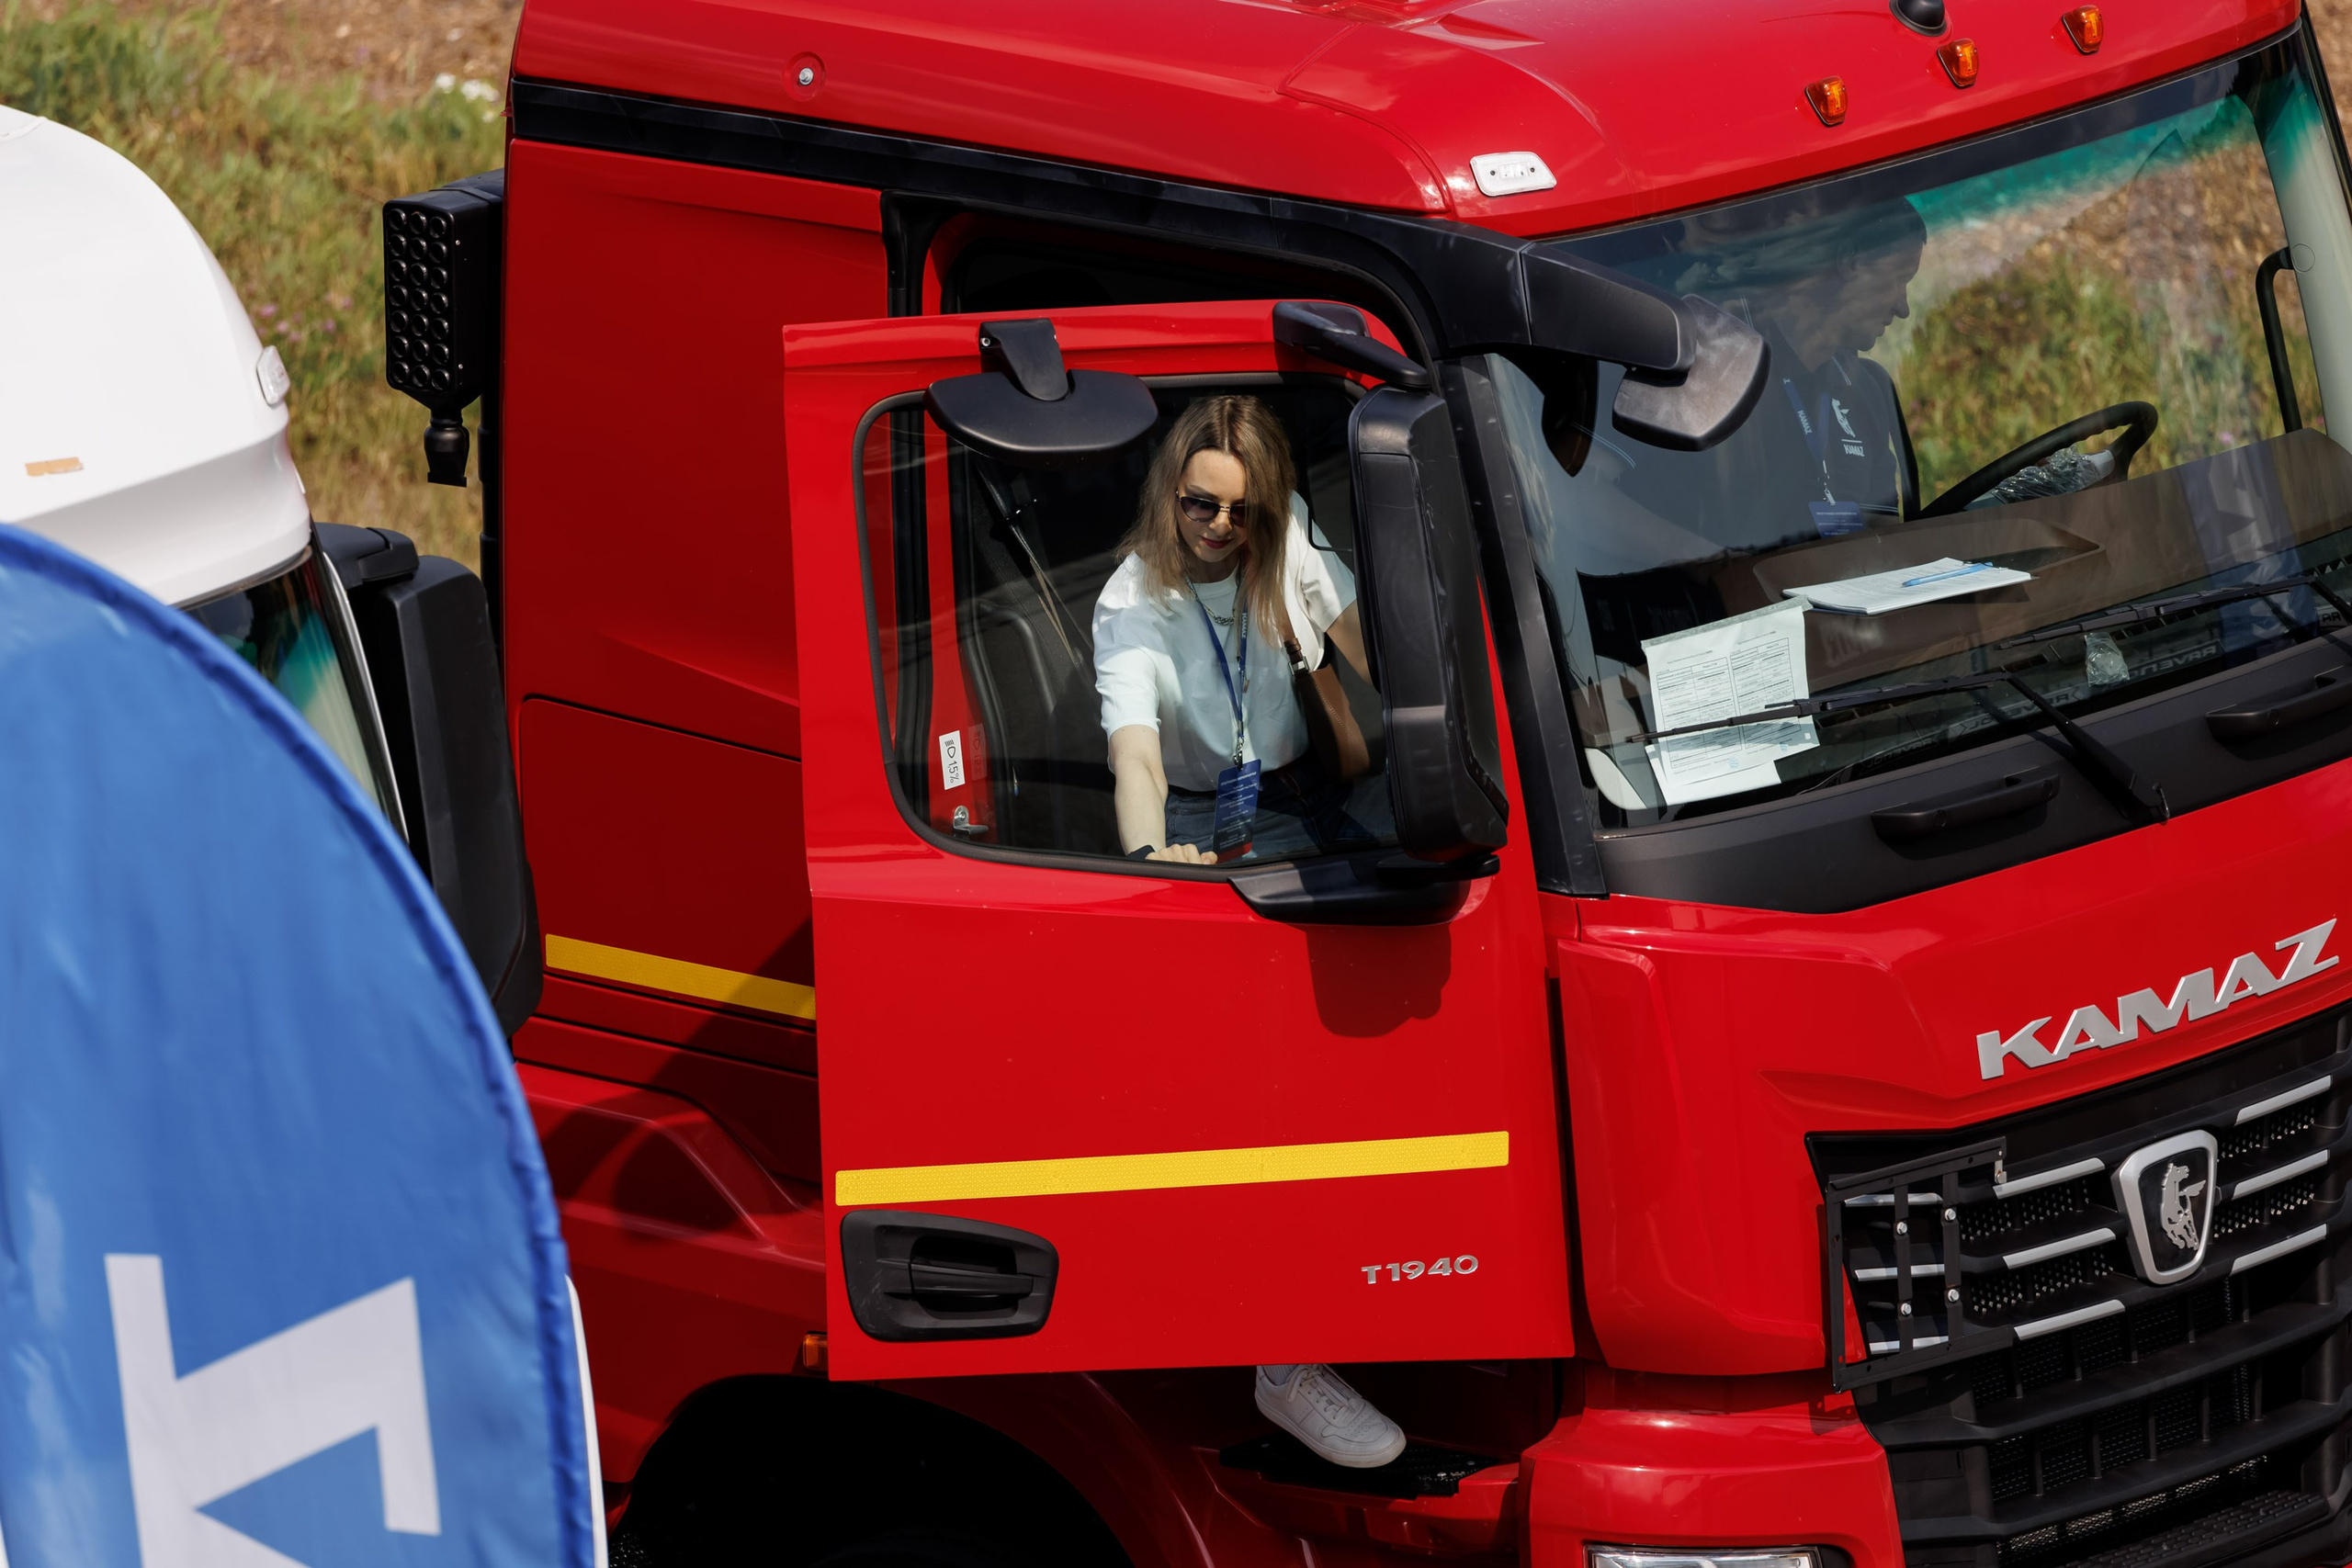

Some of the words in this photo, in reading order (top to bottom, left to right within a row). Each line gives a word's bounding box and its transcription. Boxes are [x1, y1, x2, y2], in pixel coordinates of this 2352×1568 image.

[1797, 410, 1813, 435] KAMAZ
[1843, 444, 1865, 457] KAMAZ
[1976, 918, 2339, 1080] KAMAZ
[1361, 1255, 1478, 1284] T1940
